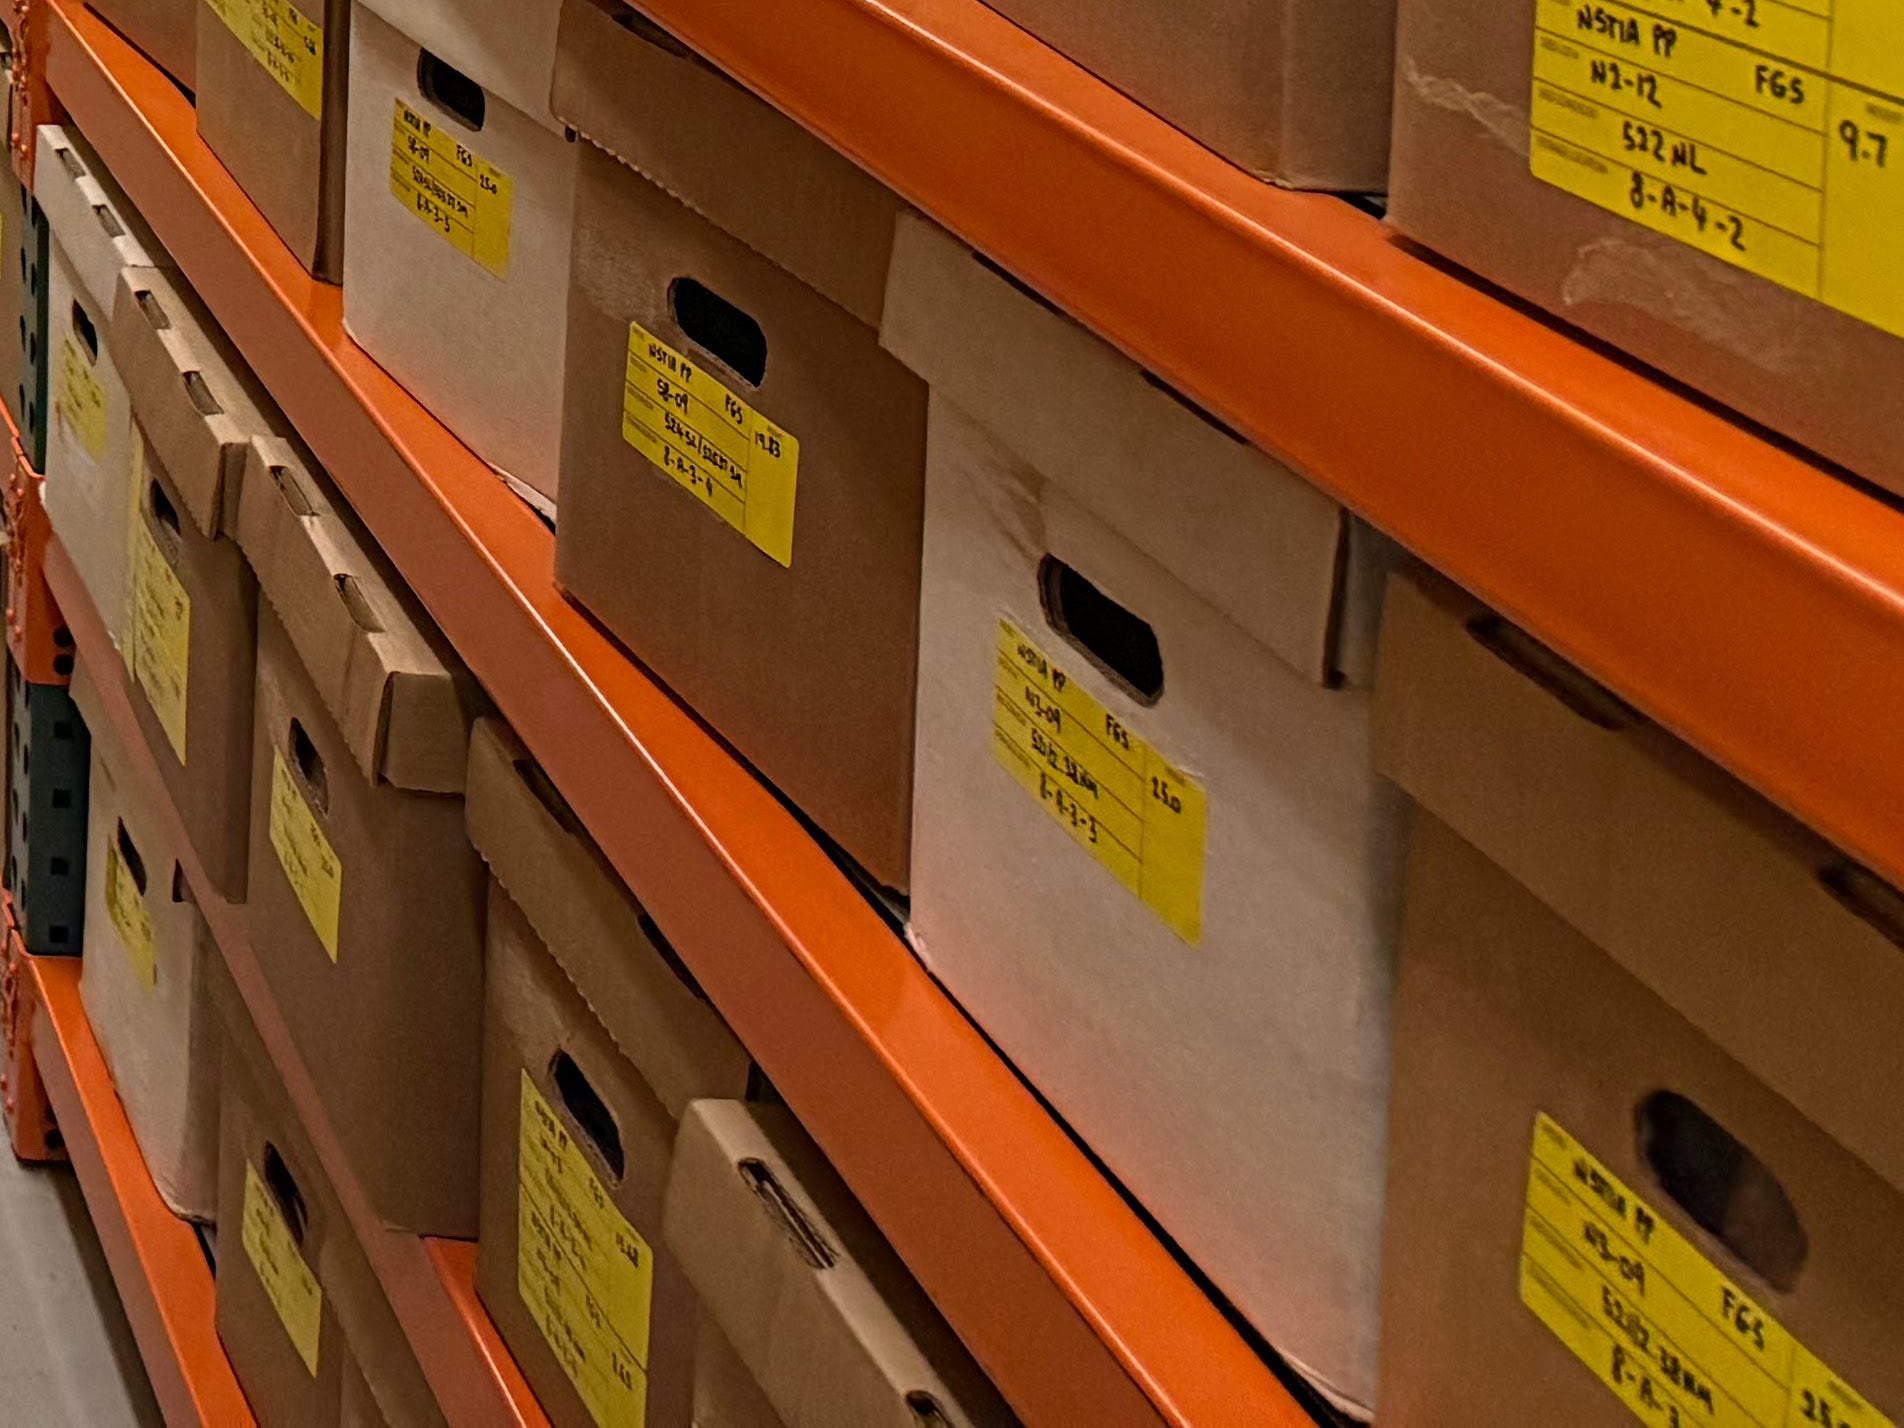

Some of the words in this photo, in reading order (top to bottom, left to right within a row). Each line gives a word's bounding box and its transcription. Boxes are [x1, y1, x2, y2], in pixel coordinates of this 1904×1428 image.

[1576, 3, 1641, 47] NSTIA
[1651, 23, 1679, 60] PP
[1753, 65, 1807, 107] FGS
[1628, 170, 1747, 253] 8-A-4-2
[724, 394, 743, 425] FGS
